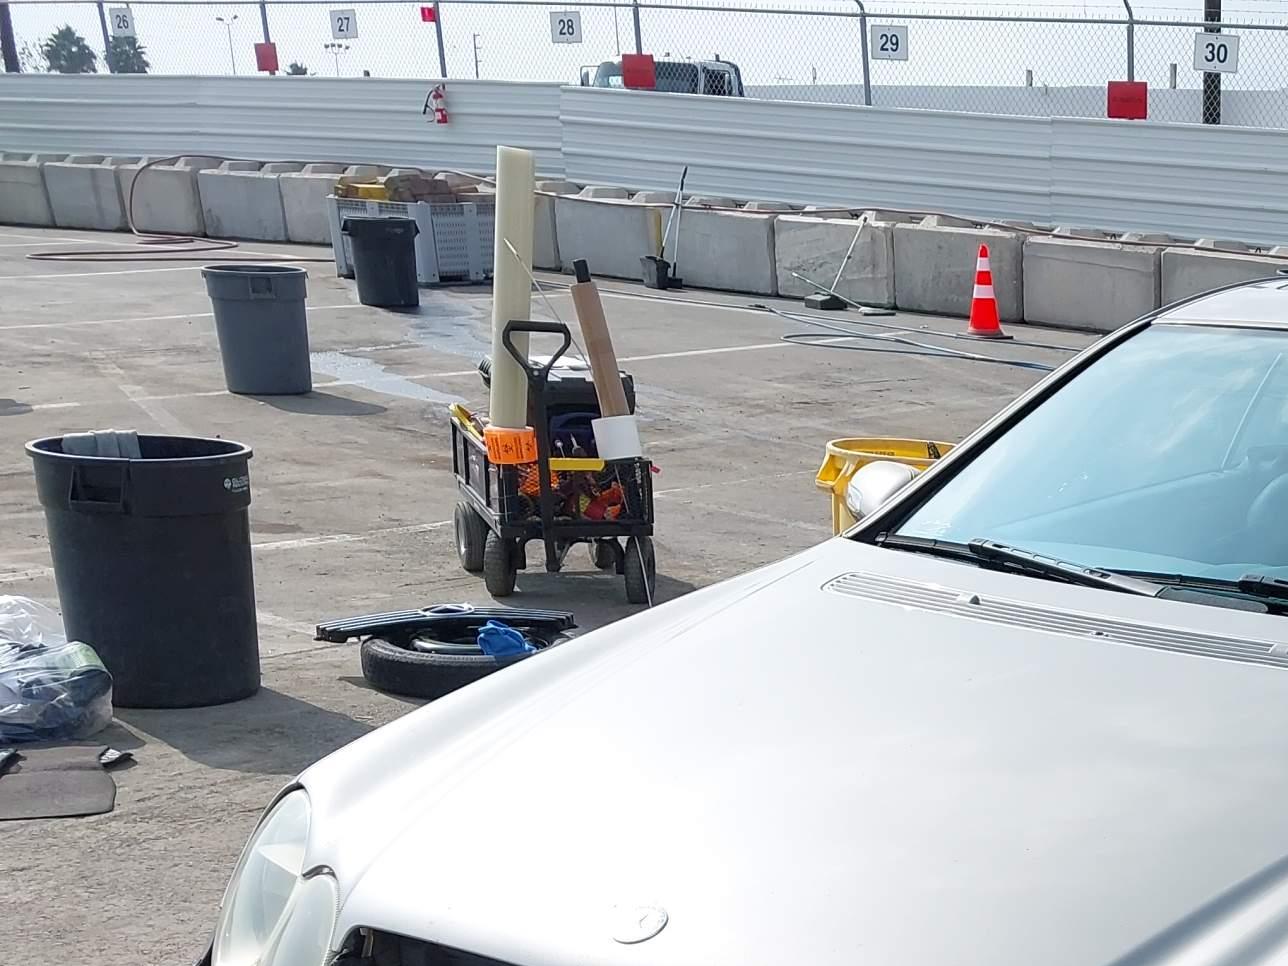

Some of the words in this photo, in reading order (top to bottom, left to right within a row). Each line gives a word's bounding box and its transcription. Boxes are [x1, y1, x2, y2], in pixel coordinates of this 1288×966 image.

[115, 14, 129, 29] 26
[337, 16, 350, 32] 27
[558, 18, 575, 36] 28
[879, 33, 899, 52] 29
[1204, 42, 1228, 63] 30
